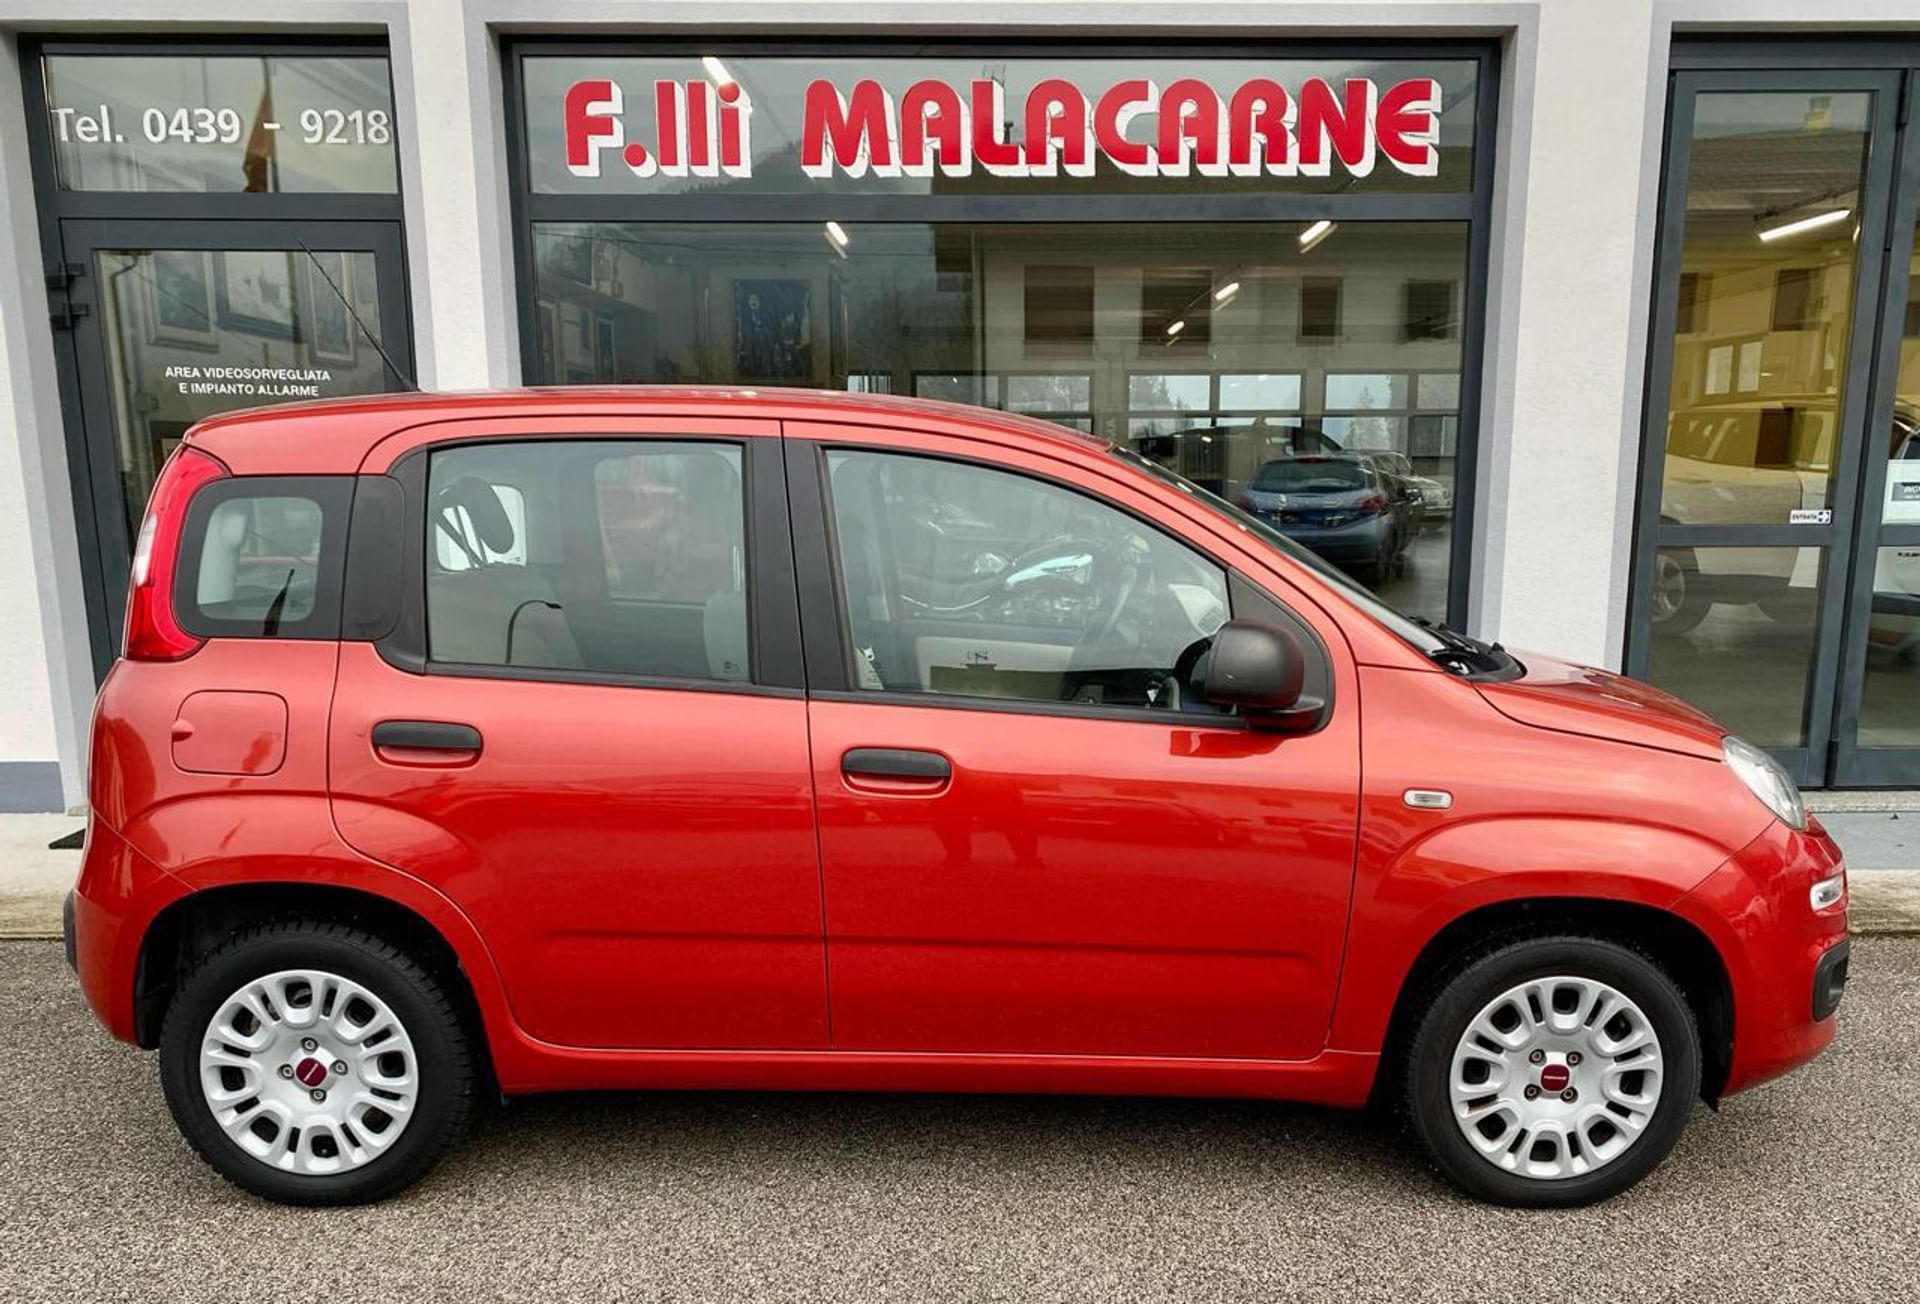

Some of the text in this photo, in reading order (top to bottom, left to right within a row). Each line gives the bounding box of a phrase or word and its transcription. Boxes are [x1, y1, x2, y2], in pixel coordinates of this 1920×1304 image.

[51, 104, 124, 143] Tel.
[142, 107, 241, 143] 0439
[300, 109, 391, 144] 9218
[800, 78, 1442, 178] MALACARNE
[165, 366, 331, 381] AREA VIDEOSORVEGLIATA
[179, 383, 319, 397] E IMPIANTO ALLARME
